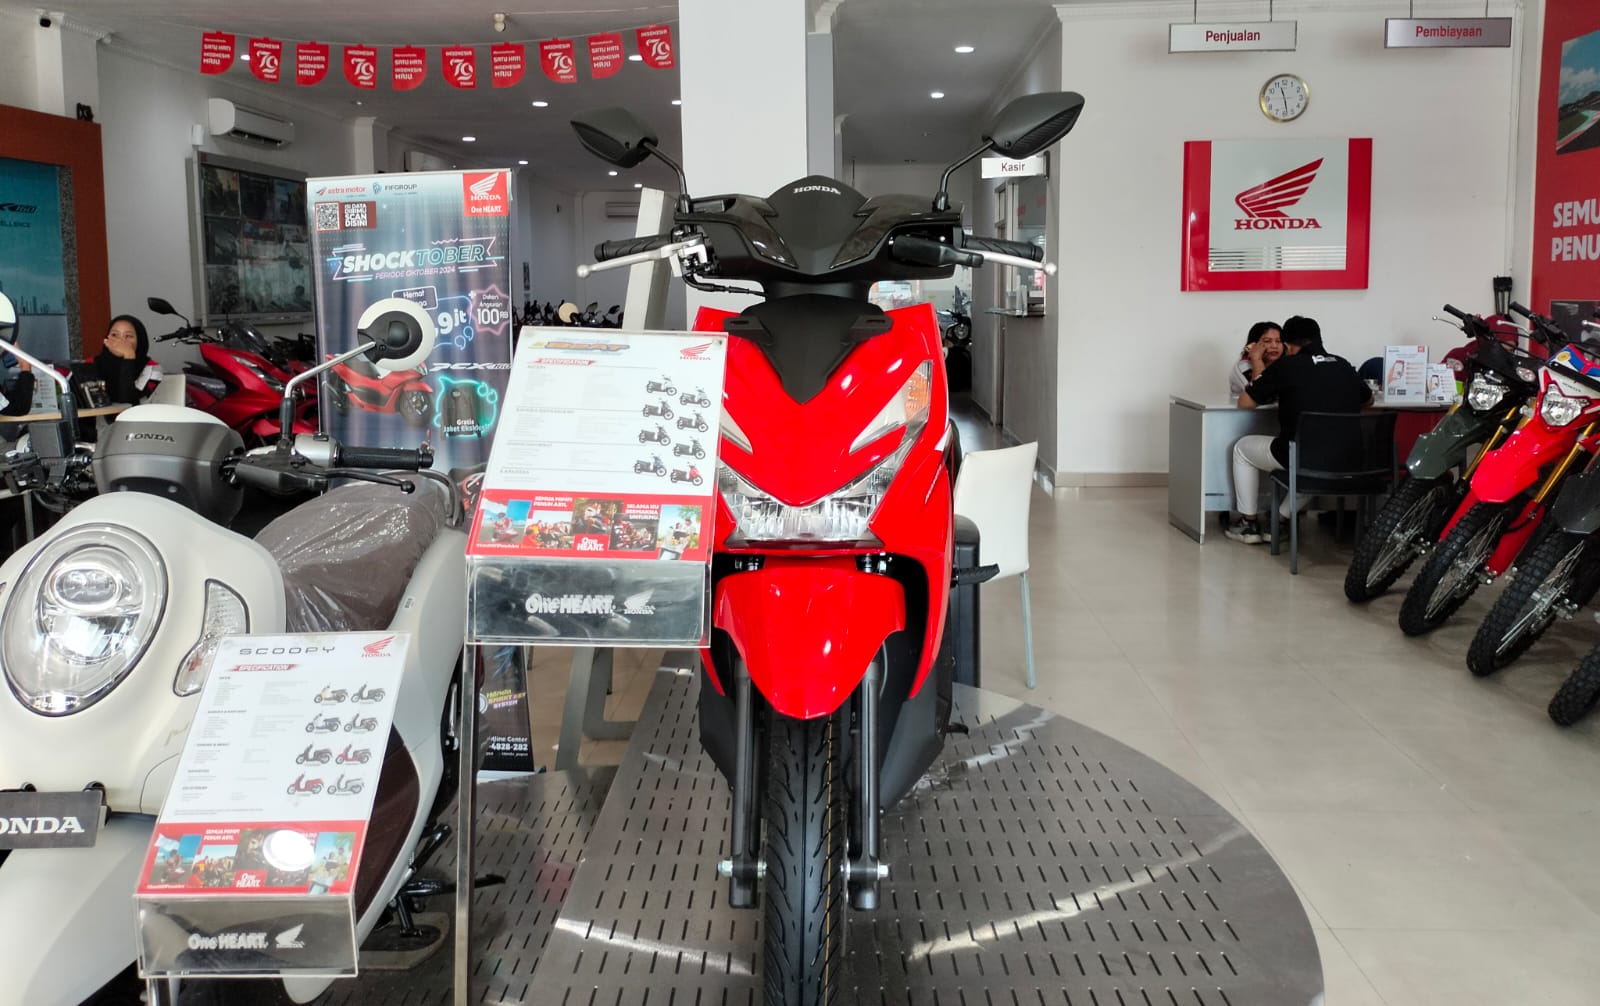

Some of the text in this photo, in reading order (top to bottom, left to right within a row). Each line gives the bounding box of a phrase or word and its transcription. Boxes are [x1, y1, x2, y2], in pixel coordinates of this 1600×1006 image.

[1206, 30, 1260, 44] Penjualan
[1416, 26, 1482, 39] Pembiayaan
[1002, 162, 1026, 172] Kasir
[794, 186, 841, 195] HONDA
[1234, 218, 1322, 230] HONDA
[376, 266, 456, 280] PERIODE OKTOBER 2024
[403, 290, 424, 298] Hemat
[582, 536, 598, 544] One
[526, 593, 560, 614] One
[240, 646, 336, 656] SCOOPY
[239, 664, 289, 672] SPECIFICATION
[242, 872, 256, 881] One
[188, 933, 218, 950] One
